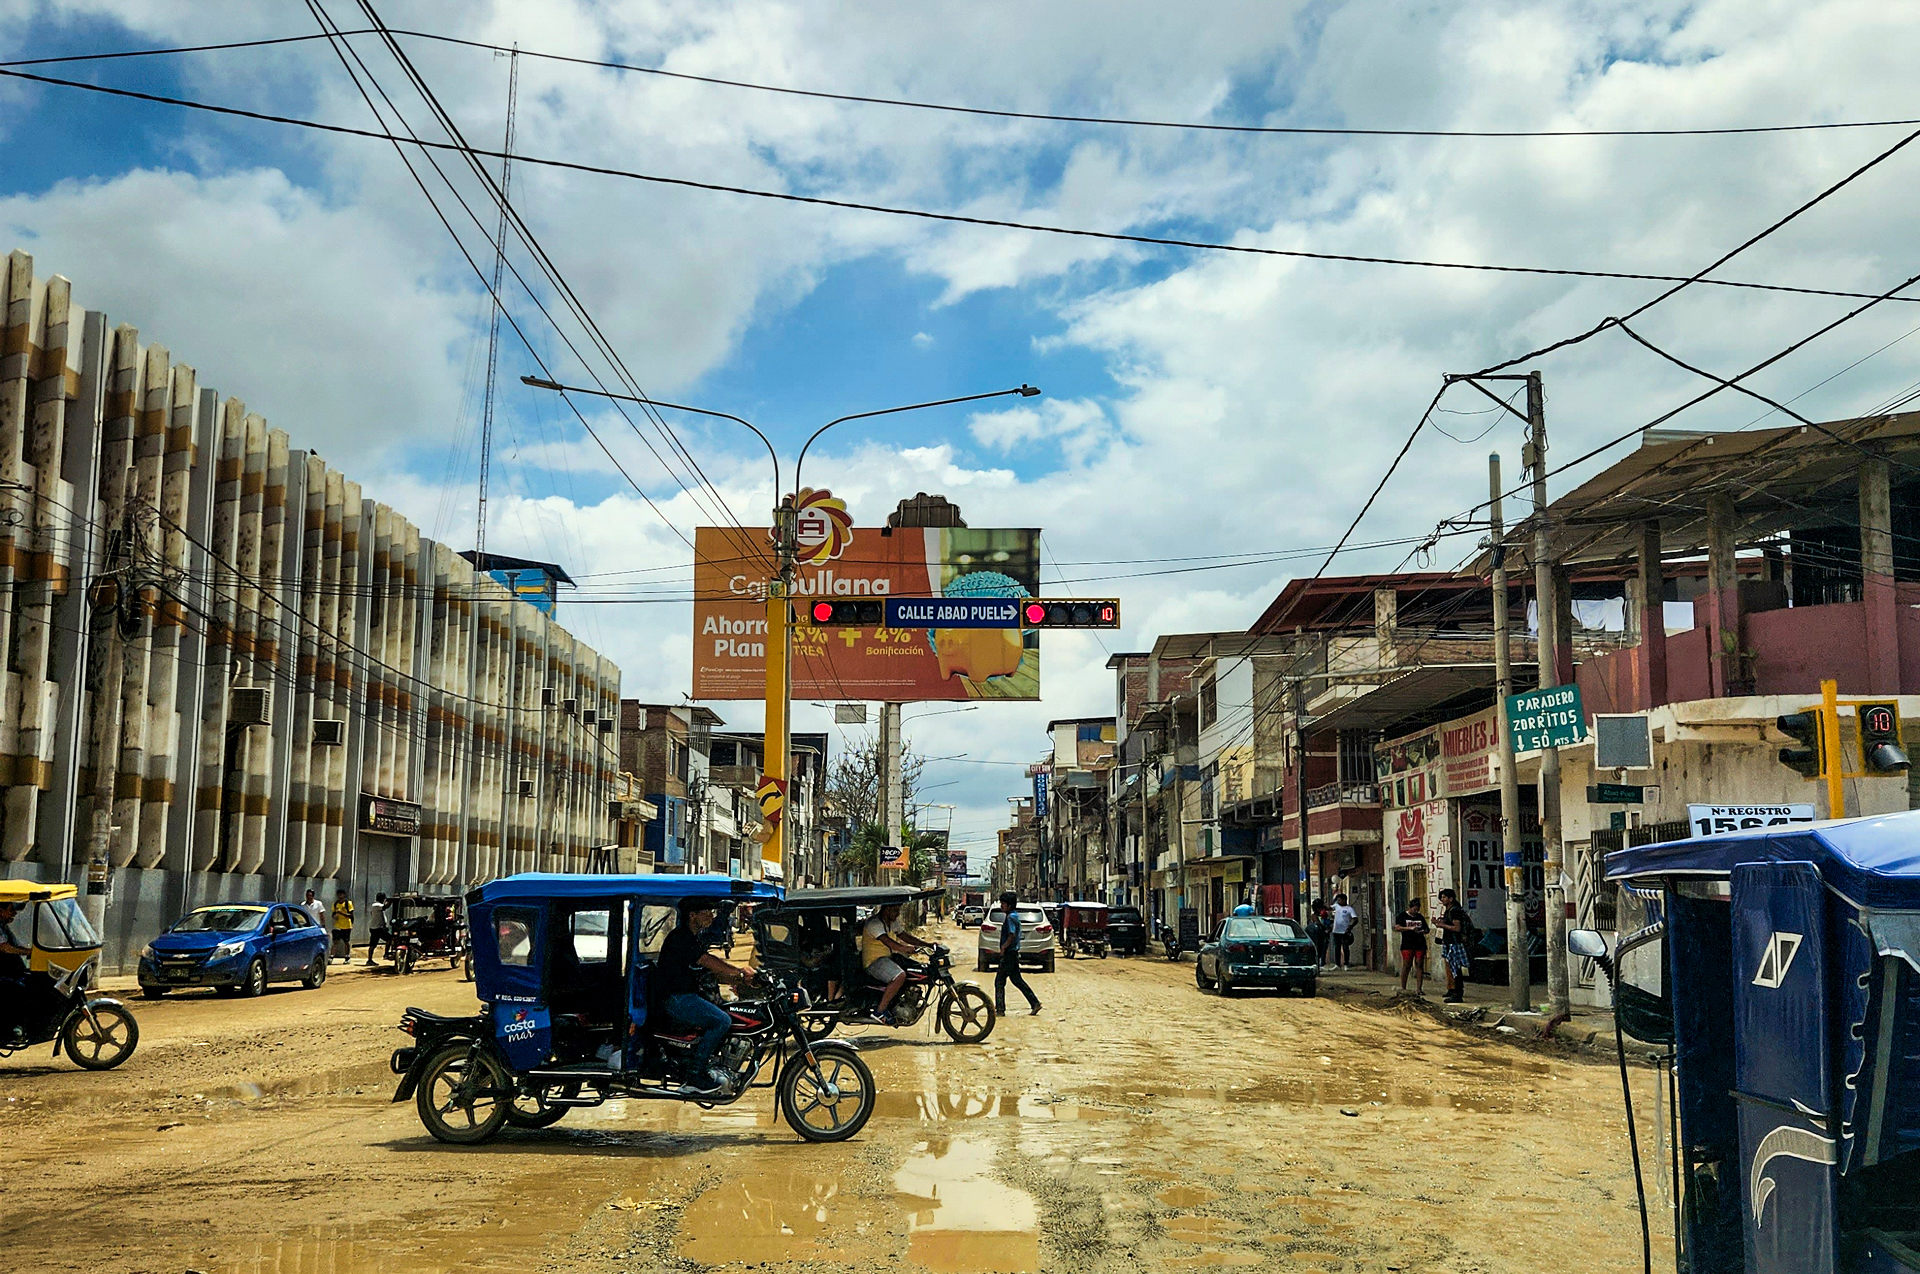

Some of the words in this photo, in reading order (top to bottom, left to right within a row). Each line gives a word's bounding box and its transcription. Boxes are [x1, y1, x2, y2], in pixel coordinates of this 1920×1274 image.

[728, 574, 768, 602] Caj
[897, 605, 934, 621] CALLE
[936, 605, 968, 621] ABAD
[1101, 607, 1114, 622] 10
[713, 638, 765, 658] Plan
[792, 645, 826, 657] TREA
[865, 645, 925, 658] Bonificación
[1516, 690, 1575, 712] PARADERO
[1512, 709, 1578, 732] ZORRITOS
[1873, 712, 1890, 731] 10
[1443, 719, 1488, 758] MUEBLES
[1554, 736, 1570, 747] MTS
[1728, 807, 1792, 817] REGISTRO
[1467, 840, 1489, 862] DE
[1268, 906, 1290, 915] SOAT
[504, 1019, 536, 1033] costa
[508, 1029, 535, 1043] mar
